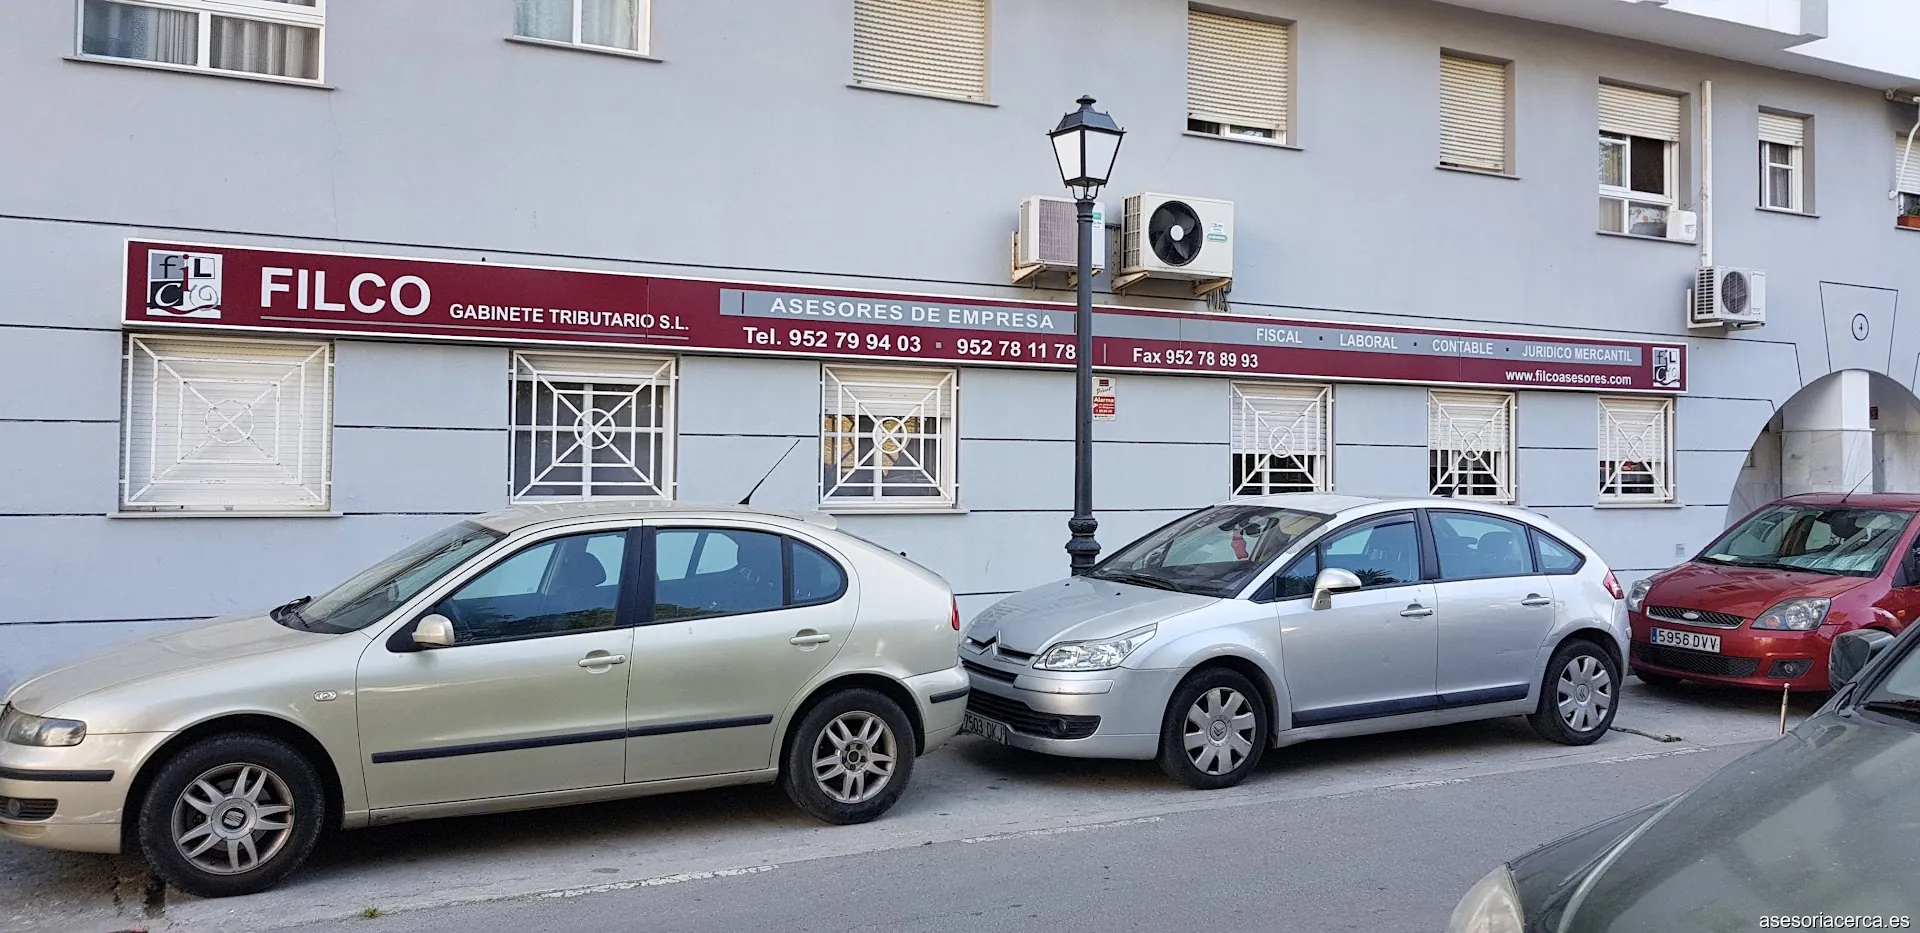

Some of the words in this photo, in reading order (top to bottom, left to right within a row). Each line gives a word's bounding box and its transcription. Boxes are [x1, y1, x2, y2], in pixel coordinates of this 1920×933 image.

[260, 266, 431, 316] FILCO
[449, 303, 544, 323] GABINETE
[549, 308, 655, 329] TRIBUTARIO
[659, 315, 690, 331] S.L.
[770, 297, 904, 321] ASESORES
[911, 306, 941, 323] DE
[949, 308, 1054, 330] EMPRESA
[742, 326, 782, 346] Tel.
[788, 329, 828, 348] 952
[834, 331, 860, 350] 79
[866, 333, 891, 351] 94
[897, 335, 921, 353] 03
[956, 338, 993, 356] 952
[998, 340, 1022, 357] 78
[1027, 342, 1047, 358] 11
[1054, 343, 1077, 360] 78
[1256, 327, 1303, 344] FISCAL
[1339, 333, 1398, 350] LABORAL
[1432, 339, 1494, 355] CONTABLE
[1522, 345, 1572, 359] JURIDICO
[1574, 348, 1633, 362] MERCANTIL
[1133, 347, 1161, 364] Fax
[1165, 350, 1194, 365] 952
[1197, 351, 1215, 366] 78
[1219, 352, 1237, 367] 89
[1240, 353, 1259, 369] 93
[1505, 369, 1632, 386] www.filcoasesores.com
[1658, 630, 1690, 646] 5956
[1692, 635, 1718, 651] DVV
